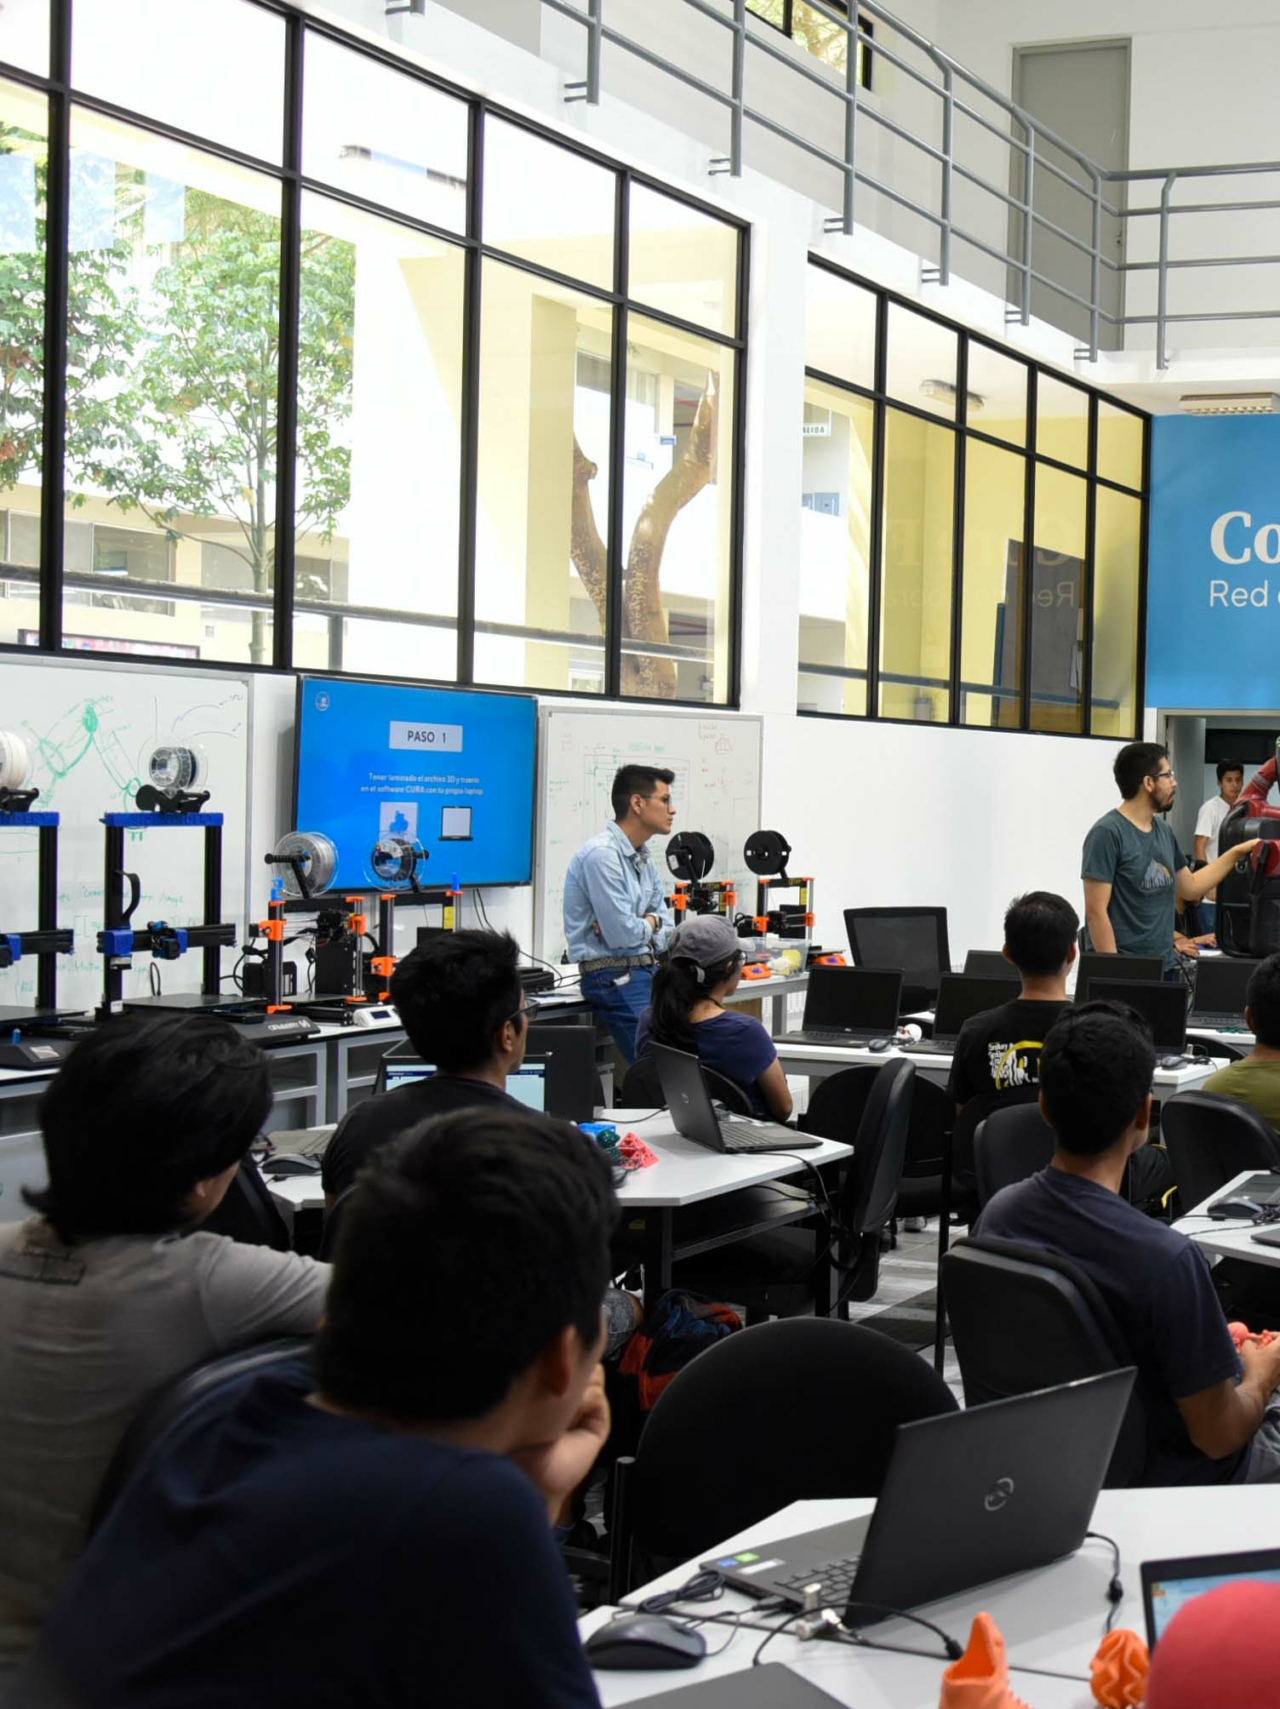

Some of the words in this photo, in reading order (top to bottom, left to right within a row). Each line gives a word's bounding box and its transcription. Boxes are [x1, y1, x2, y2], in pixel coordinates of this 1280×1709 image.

[1209, 579, 1269, 608] Red
[407, 730, 435, 743] PASO
[441, 731, 447, 743] 1
